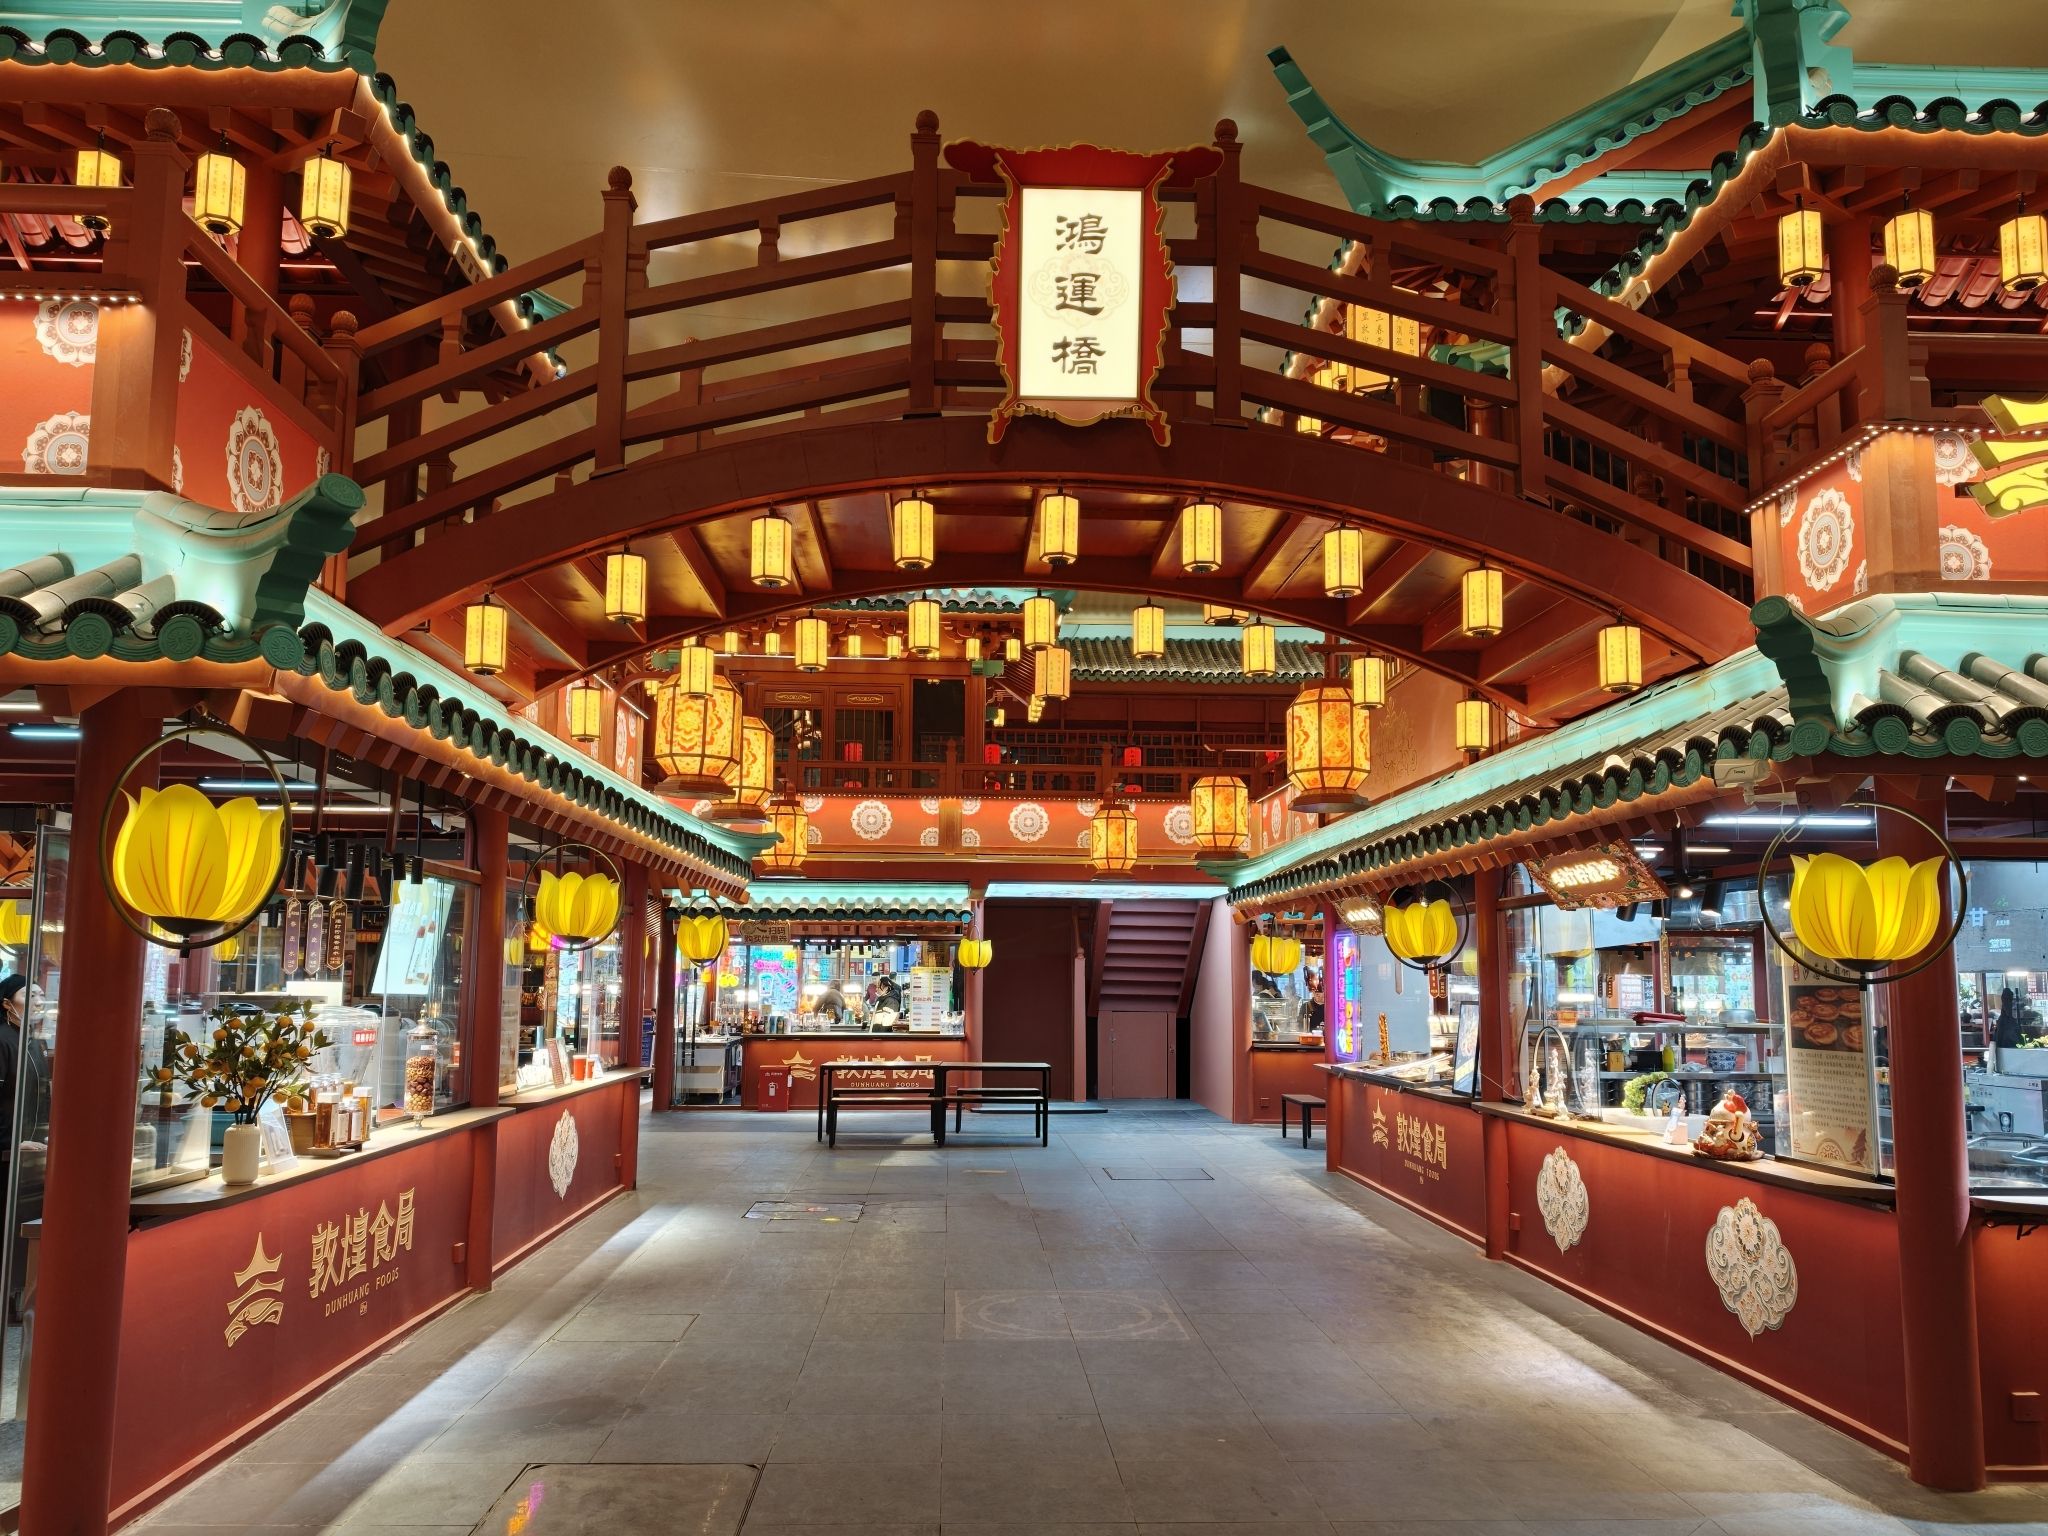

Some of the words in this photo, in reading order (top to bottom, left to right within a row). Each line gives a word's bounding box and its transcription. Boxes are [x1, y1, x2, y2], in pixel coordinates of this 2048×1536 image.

[768, 926, 786, 935] 扫码
[836, 1054, 935, 1080] 敦煌食局
[1396, 1111, 1447, 1170] 敦煌食局
[308, 1187, 416, 1299] 敦煌食局
[325, 1283, 370, 1317] DUNHUANG
[375, 1267, 399, 1290] FOODS
